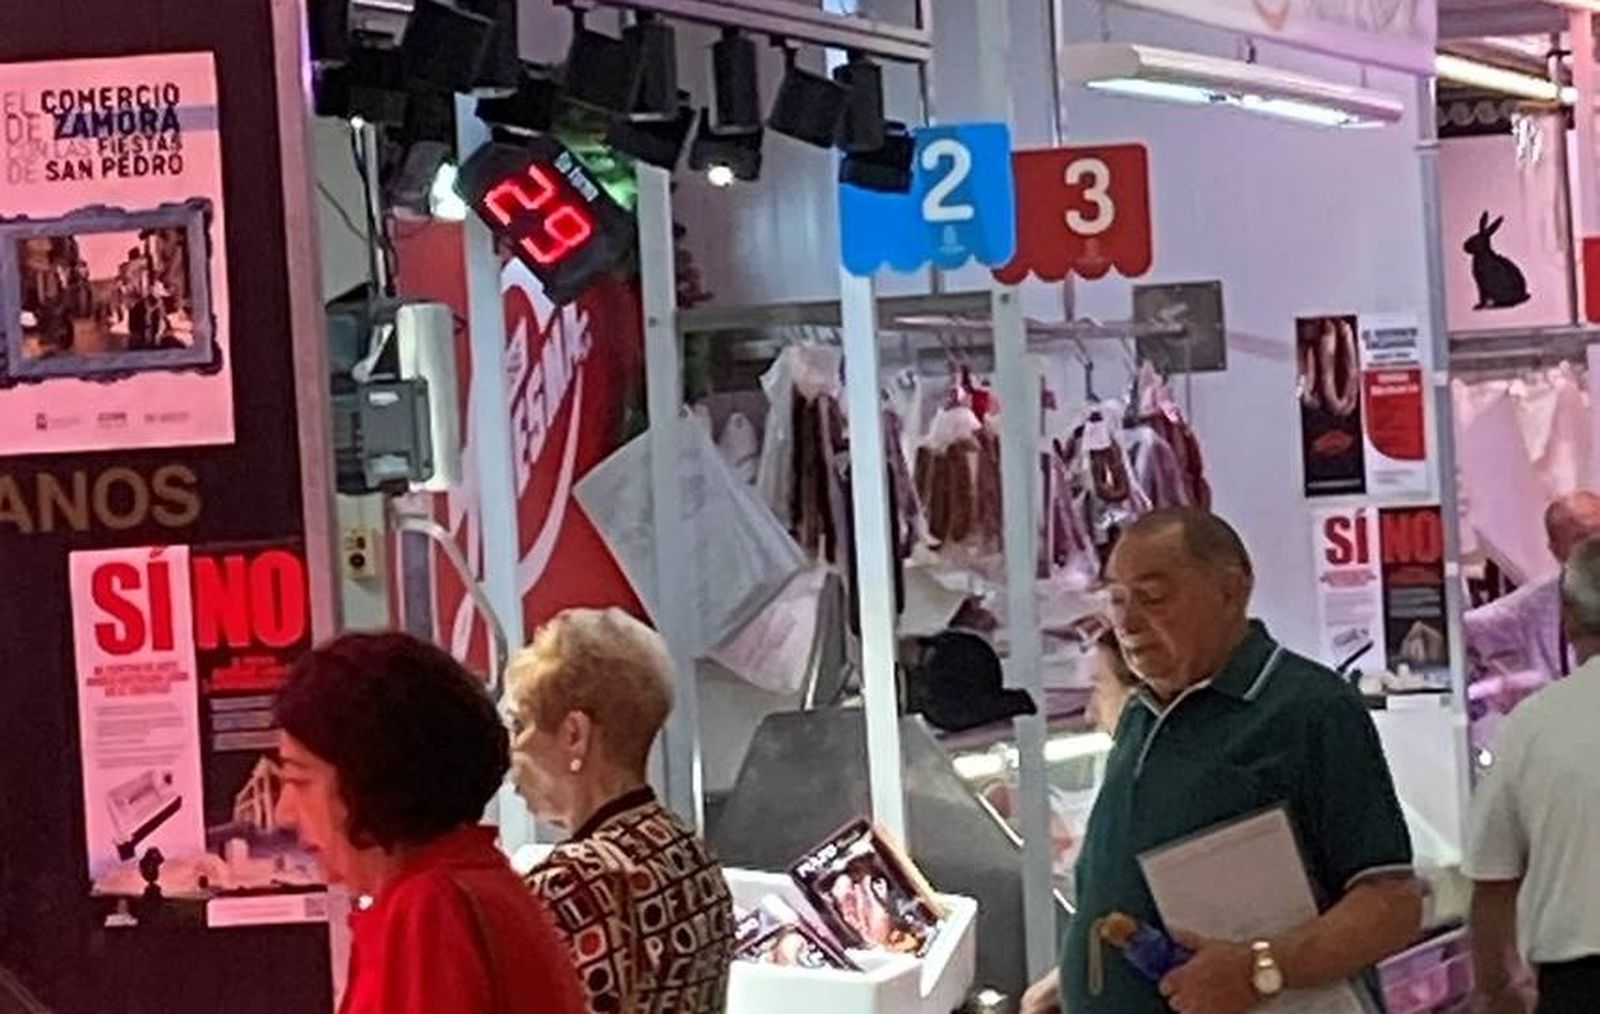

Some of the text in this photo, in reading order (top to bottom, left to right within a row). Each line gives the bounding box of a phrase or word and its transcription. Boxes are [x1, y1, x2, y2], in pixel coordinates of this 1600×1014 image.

[4, 83, 180, 118] EL COMERCIO
[5, 105, 181, 146] DE ZAMORA
[45, 158, 93, 182] SAN
[101, 153, 183, 178] PEDRO
[97, 134, 183, 156] FIESTAS
[921, 139, 975, 222] 2
[1065, 157, 1115, 235] 3
[484, 164, 592, 264] 29
[1325, 507, 1442, 566] SÍ NO
[91, 545, 306, 655] SÍ NO
